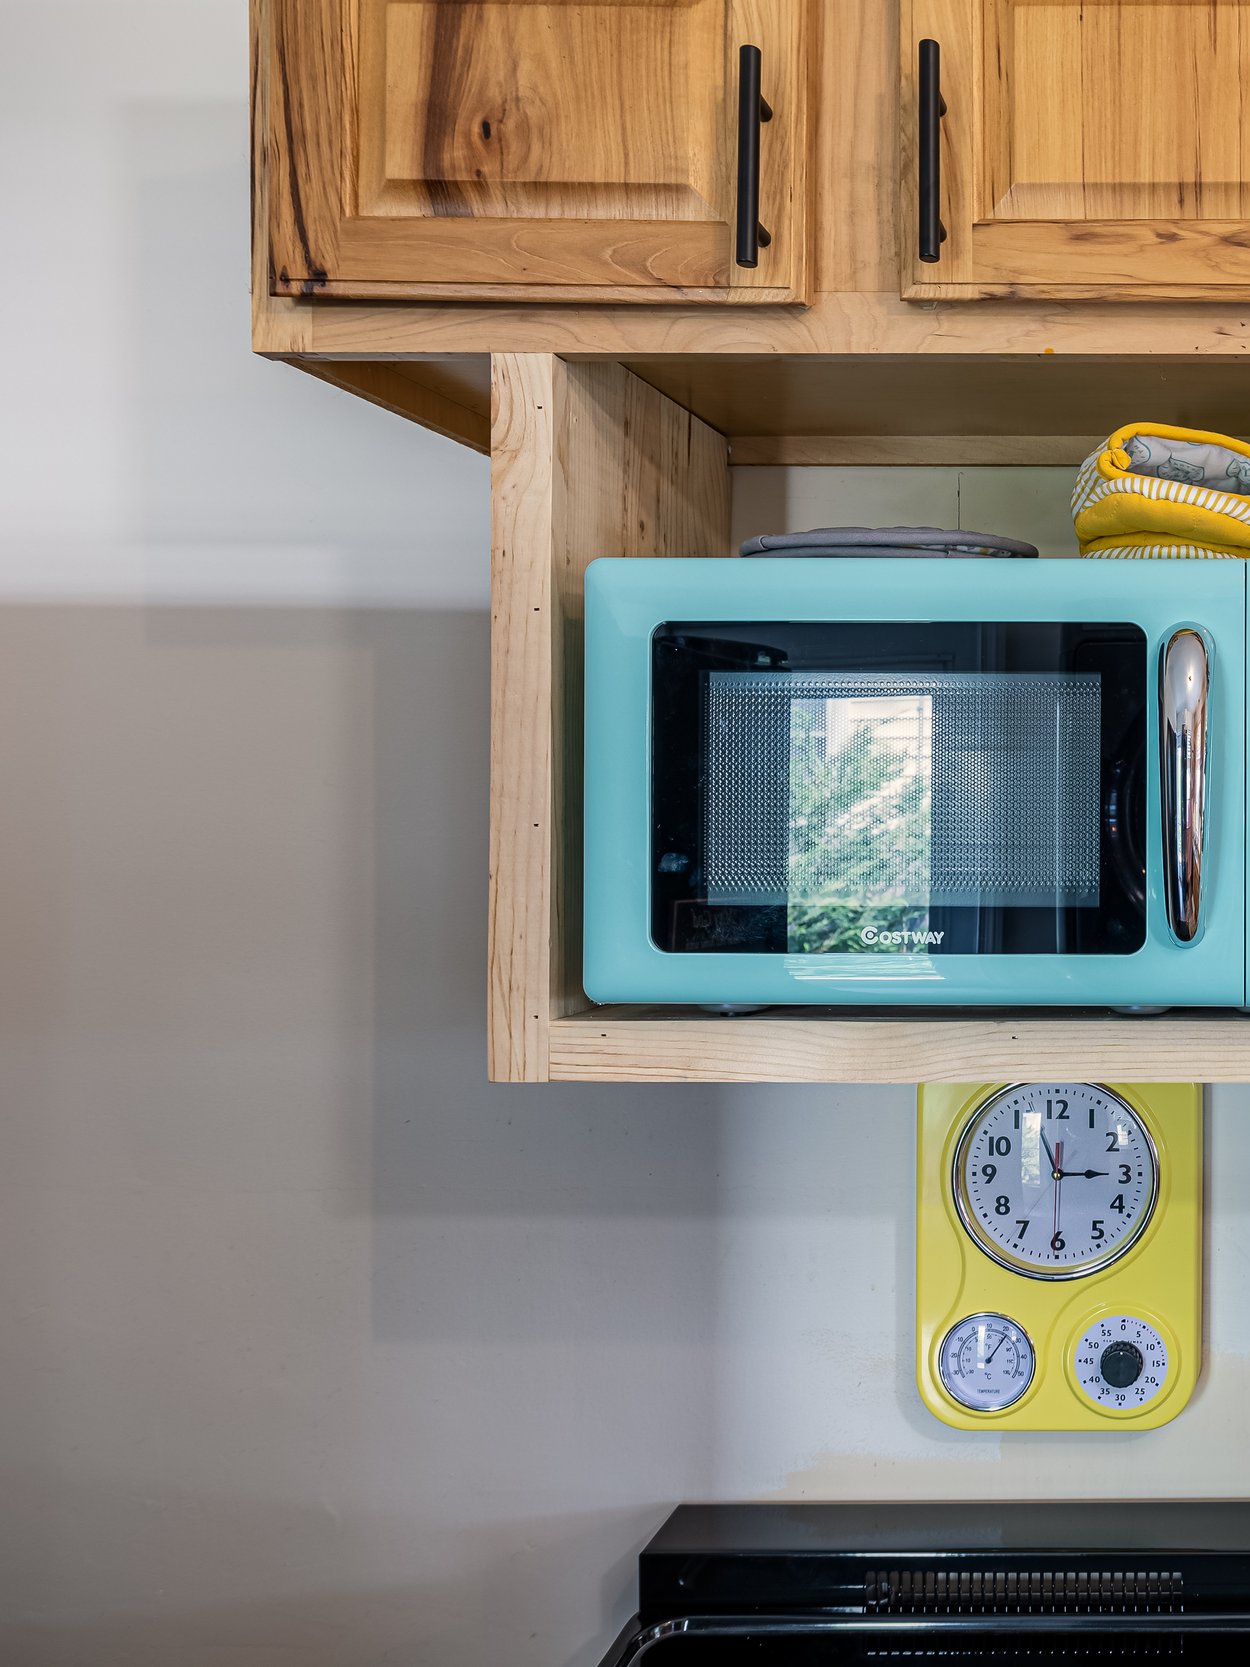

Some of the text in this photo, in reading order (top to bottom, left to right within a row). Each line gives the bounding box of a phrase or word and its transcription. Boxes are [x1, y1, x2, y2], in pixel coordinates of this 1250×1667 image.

[861, 926, 945, 945] COSTWAY
[1046, 1099, 1070, 1120] 12
[1088, 1108, 1095, 1129] 1
[988, 1136, 1012, 1156] 10
[1105, 1131, 1120, 1152] 2
[981, 1164, 997, 1184] 9
[1117, 1164, 1132, 1184] 3
[994, 1195, 1011, 1216] 8
[1109, 1194, 1126, 1214] 4
[1015, 1220, 1030, 1239] 7
[1090, 1220, 1105, 1240] 5
[1050, 1230, 1066, 1251] 6
[1146, 1343, 1155, 1351] 10
[1083, 1357, 1094, 1365] 45
[1144, 1376, 1156, 1384] 20
[1114, 1394, 1126, 1402] 30
